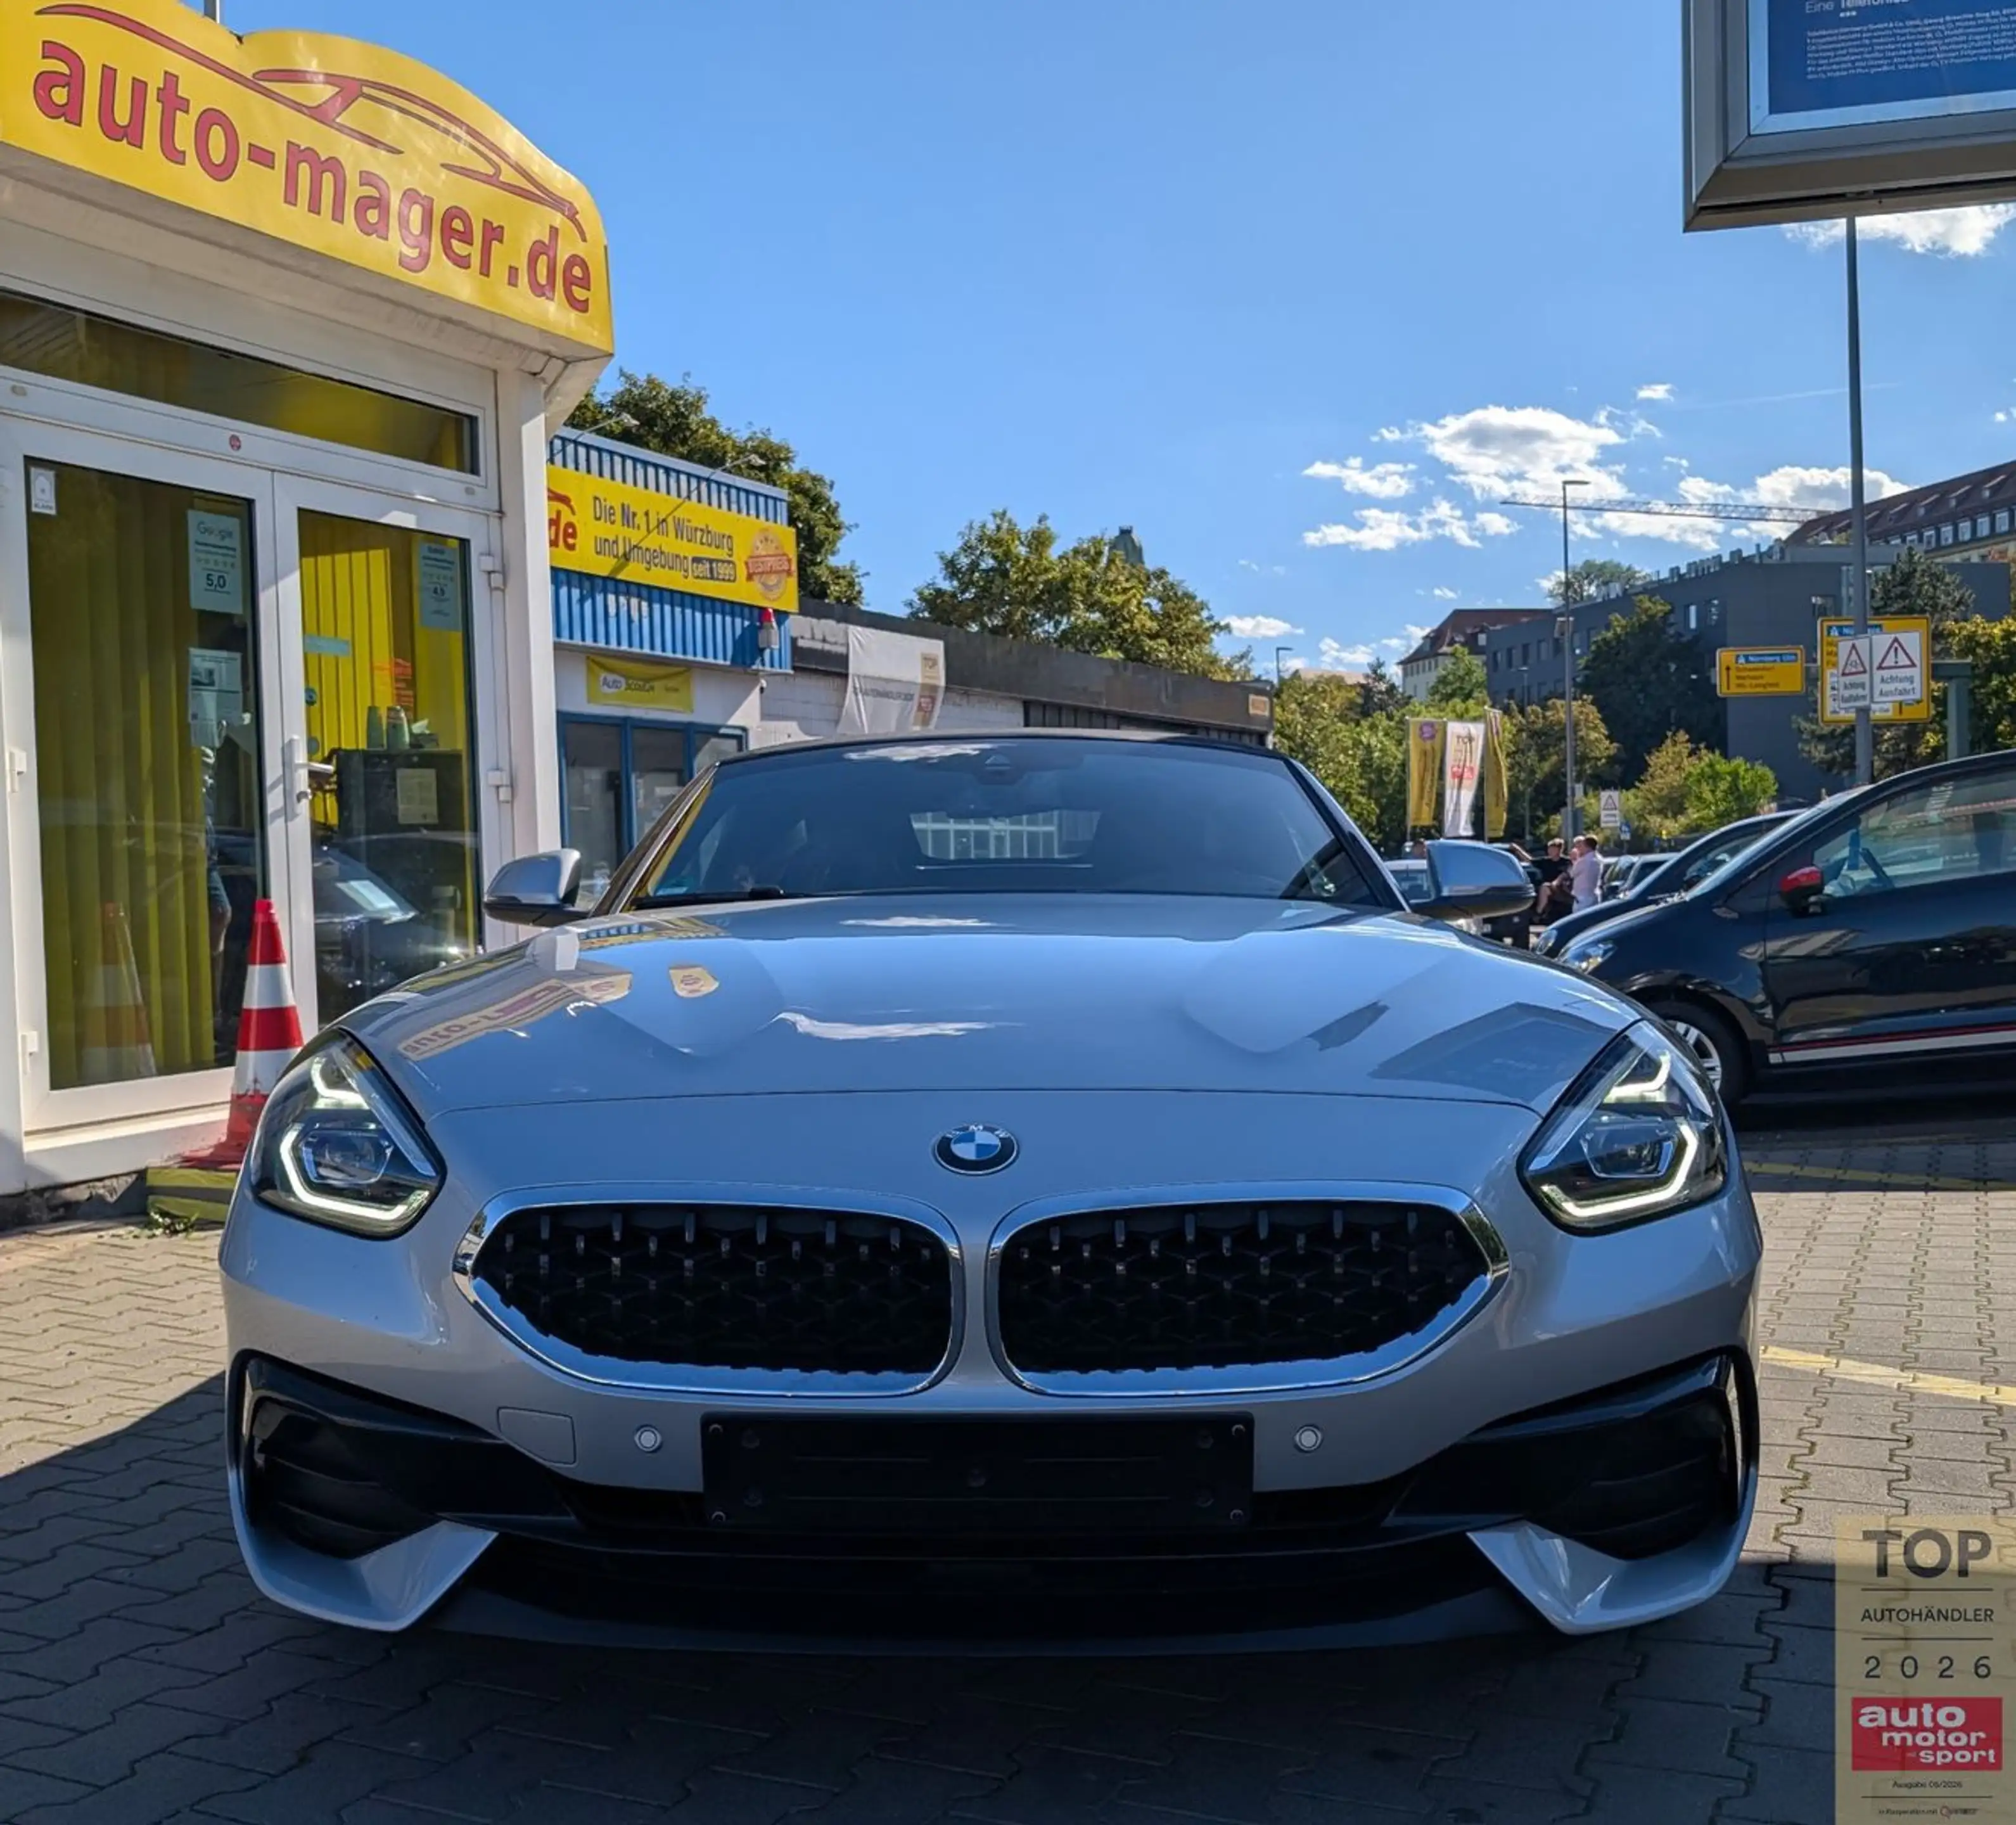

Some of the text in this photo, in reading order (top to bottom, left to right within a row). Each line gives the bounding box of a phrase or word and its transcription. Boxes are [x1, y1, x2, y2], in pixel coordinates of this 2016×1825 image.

[1806, 1, 1834, 13] Eine
[32, 41, 592, 314] auto-mager.de
[549, 509, 578, 551] de
[593, 495, 734, 558] Die Nr. 1 in Würzburg
[594, 534, 620, 559] und
[623, 535, 689, 579] Umgebung
[206, 573, 227, 591] 5,0
[1879, 687, 1916, 696] Ausfahrt
[1880, 674, 1915, 684] Achtung
